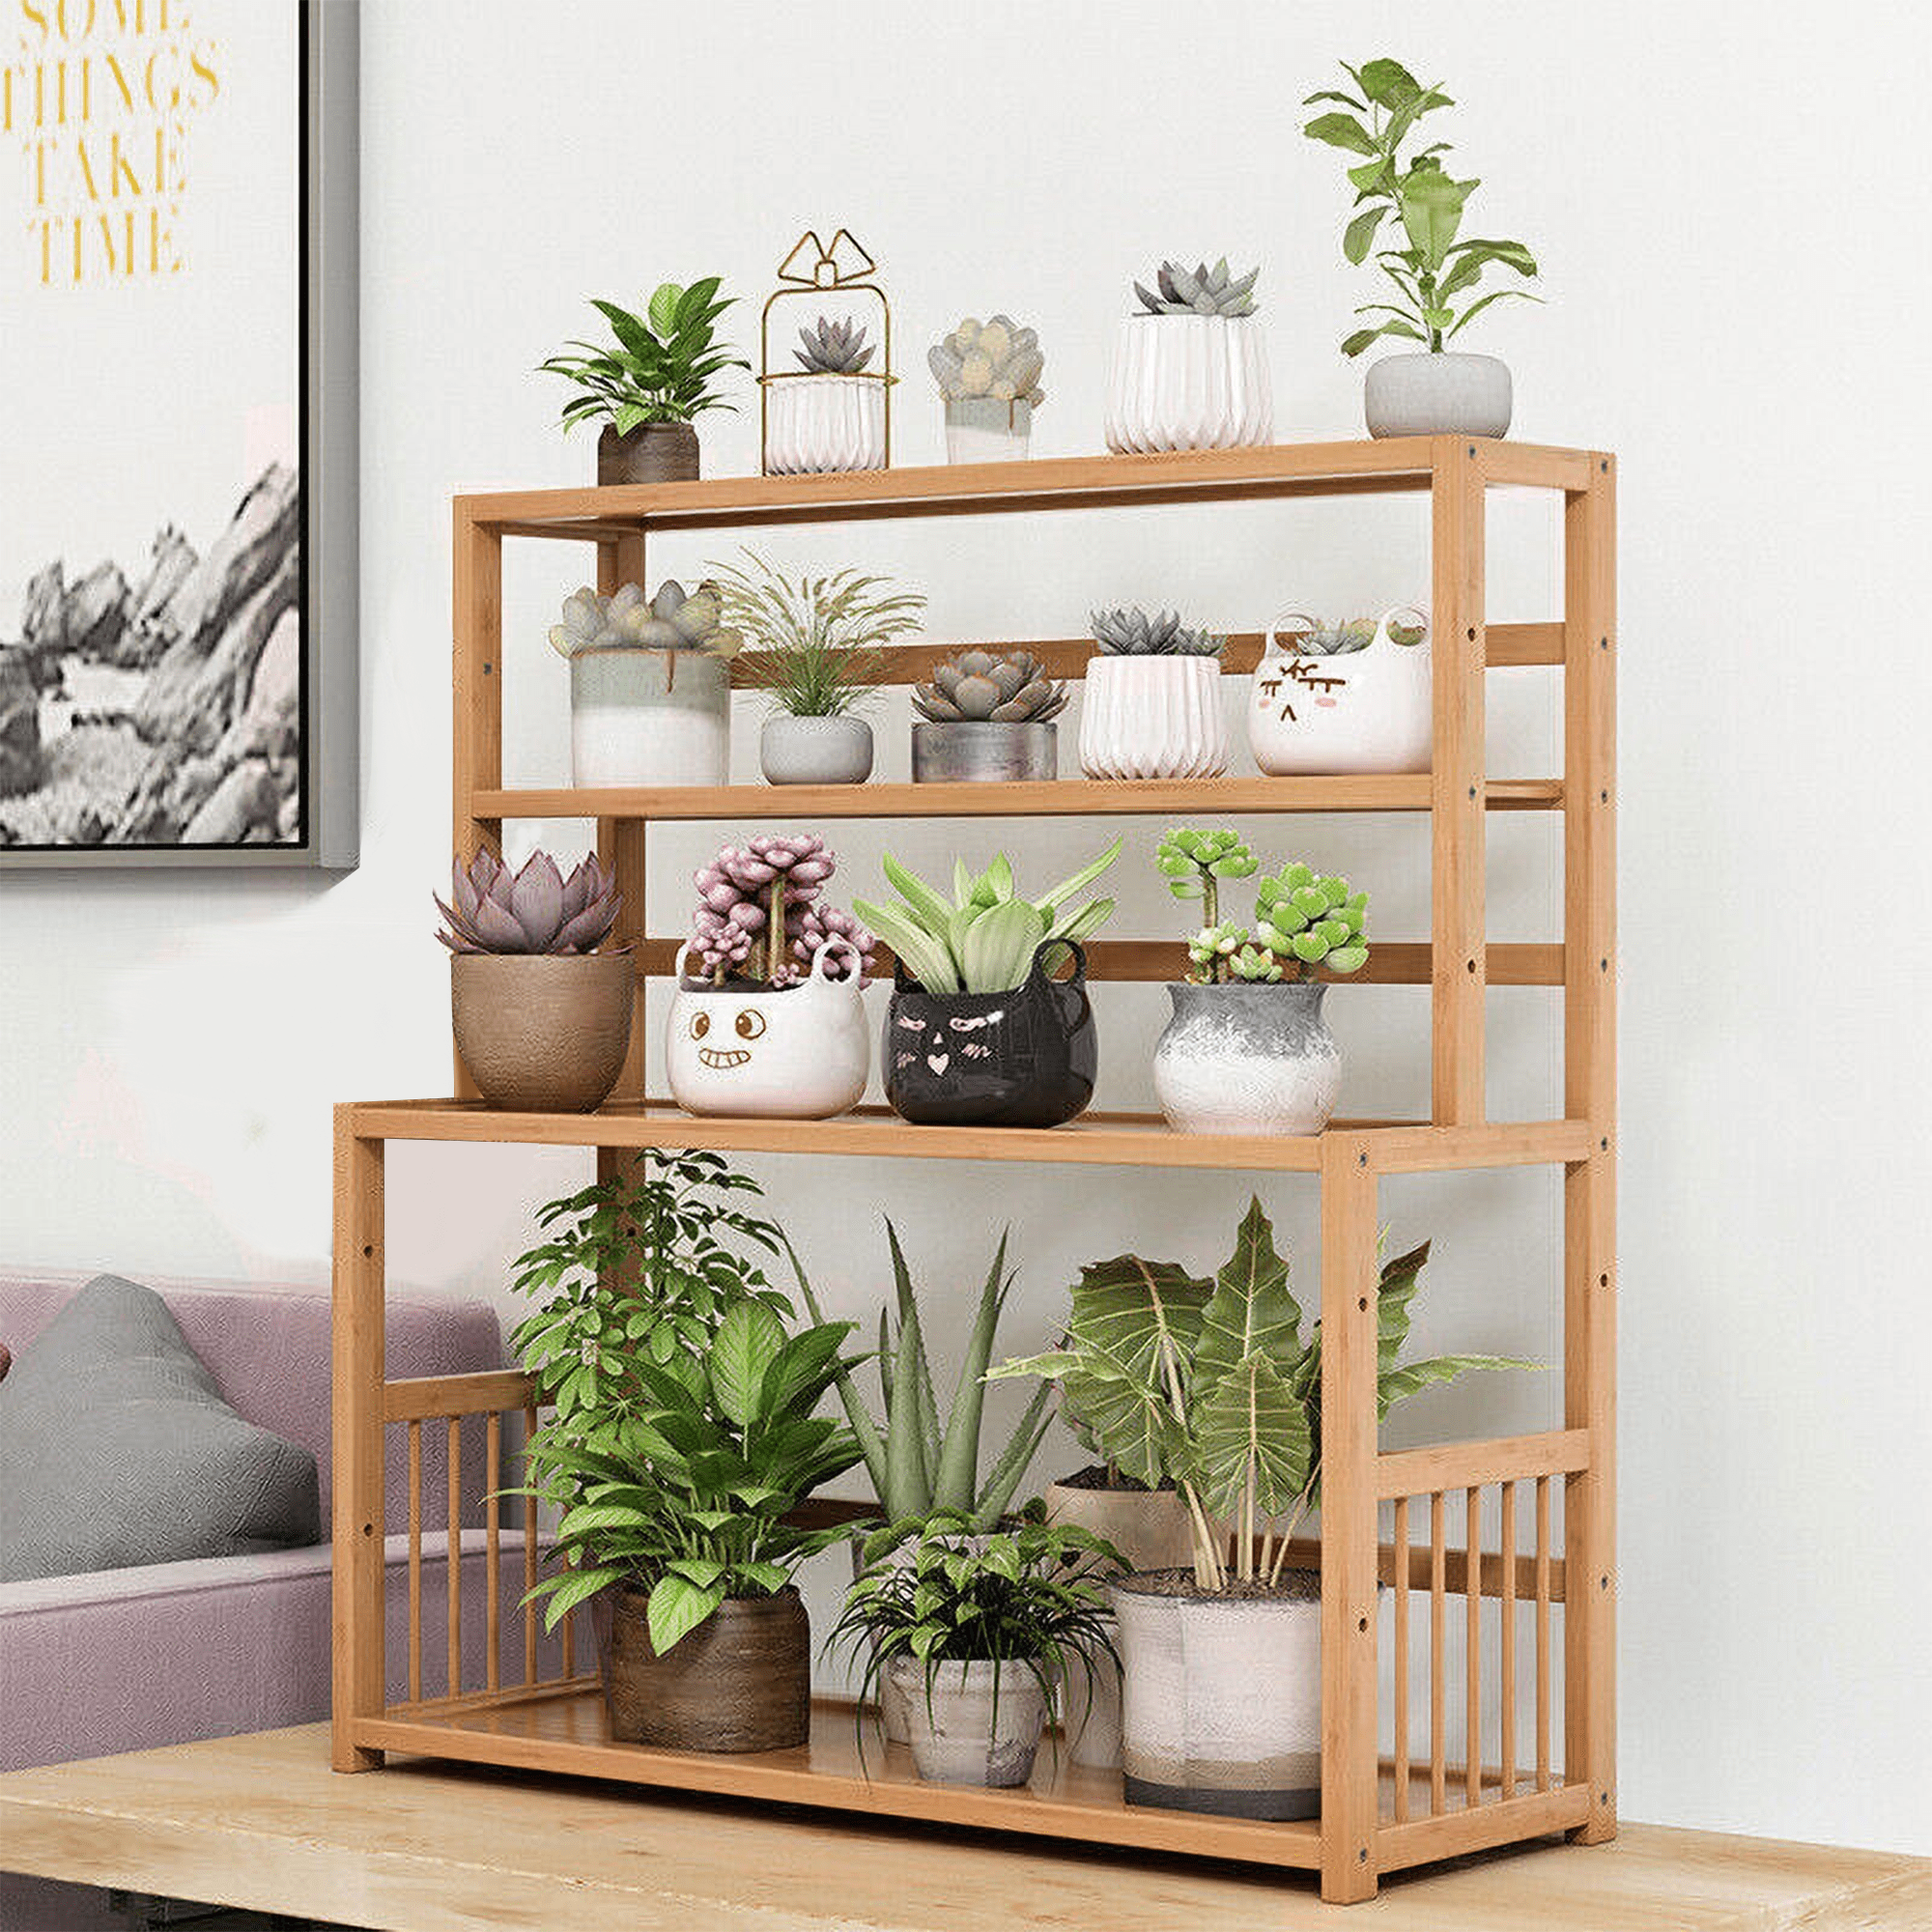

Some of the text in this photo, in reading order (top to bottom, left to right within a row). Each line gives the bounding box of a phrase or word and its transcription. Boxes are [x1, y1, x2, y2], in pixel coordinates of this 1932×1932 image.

[0, 42, 219, 131] THINGS
[24, 124, 185, 204] TAKE
[28, 205, 181, 283] TIME
